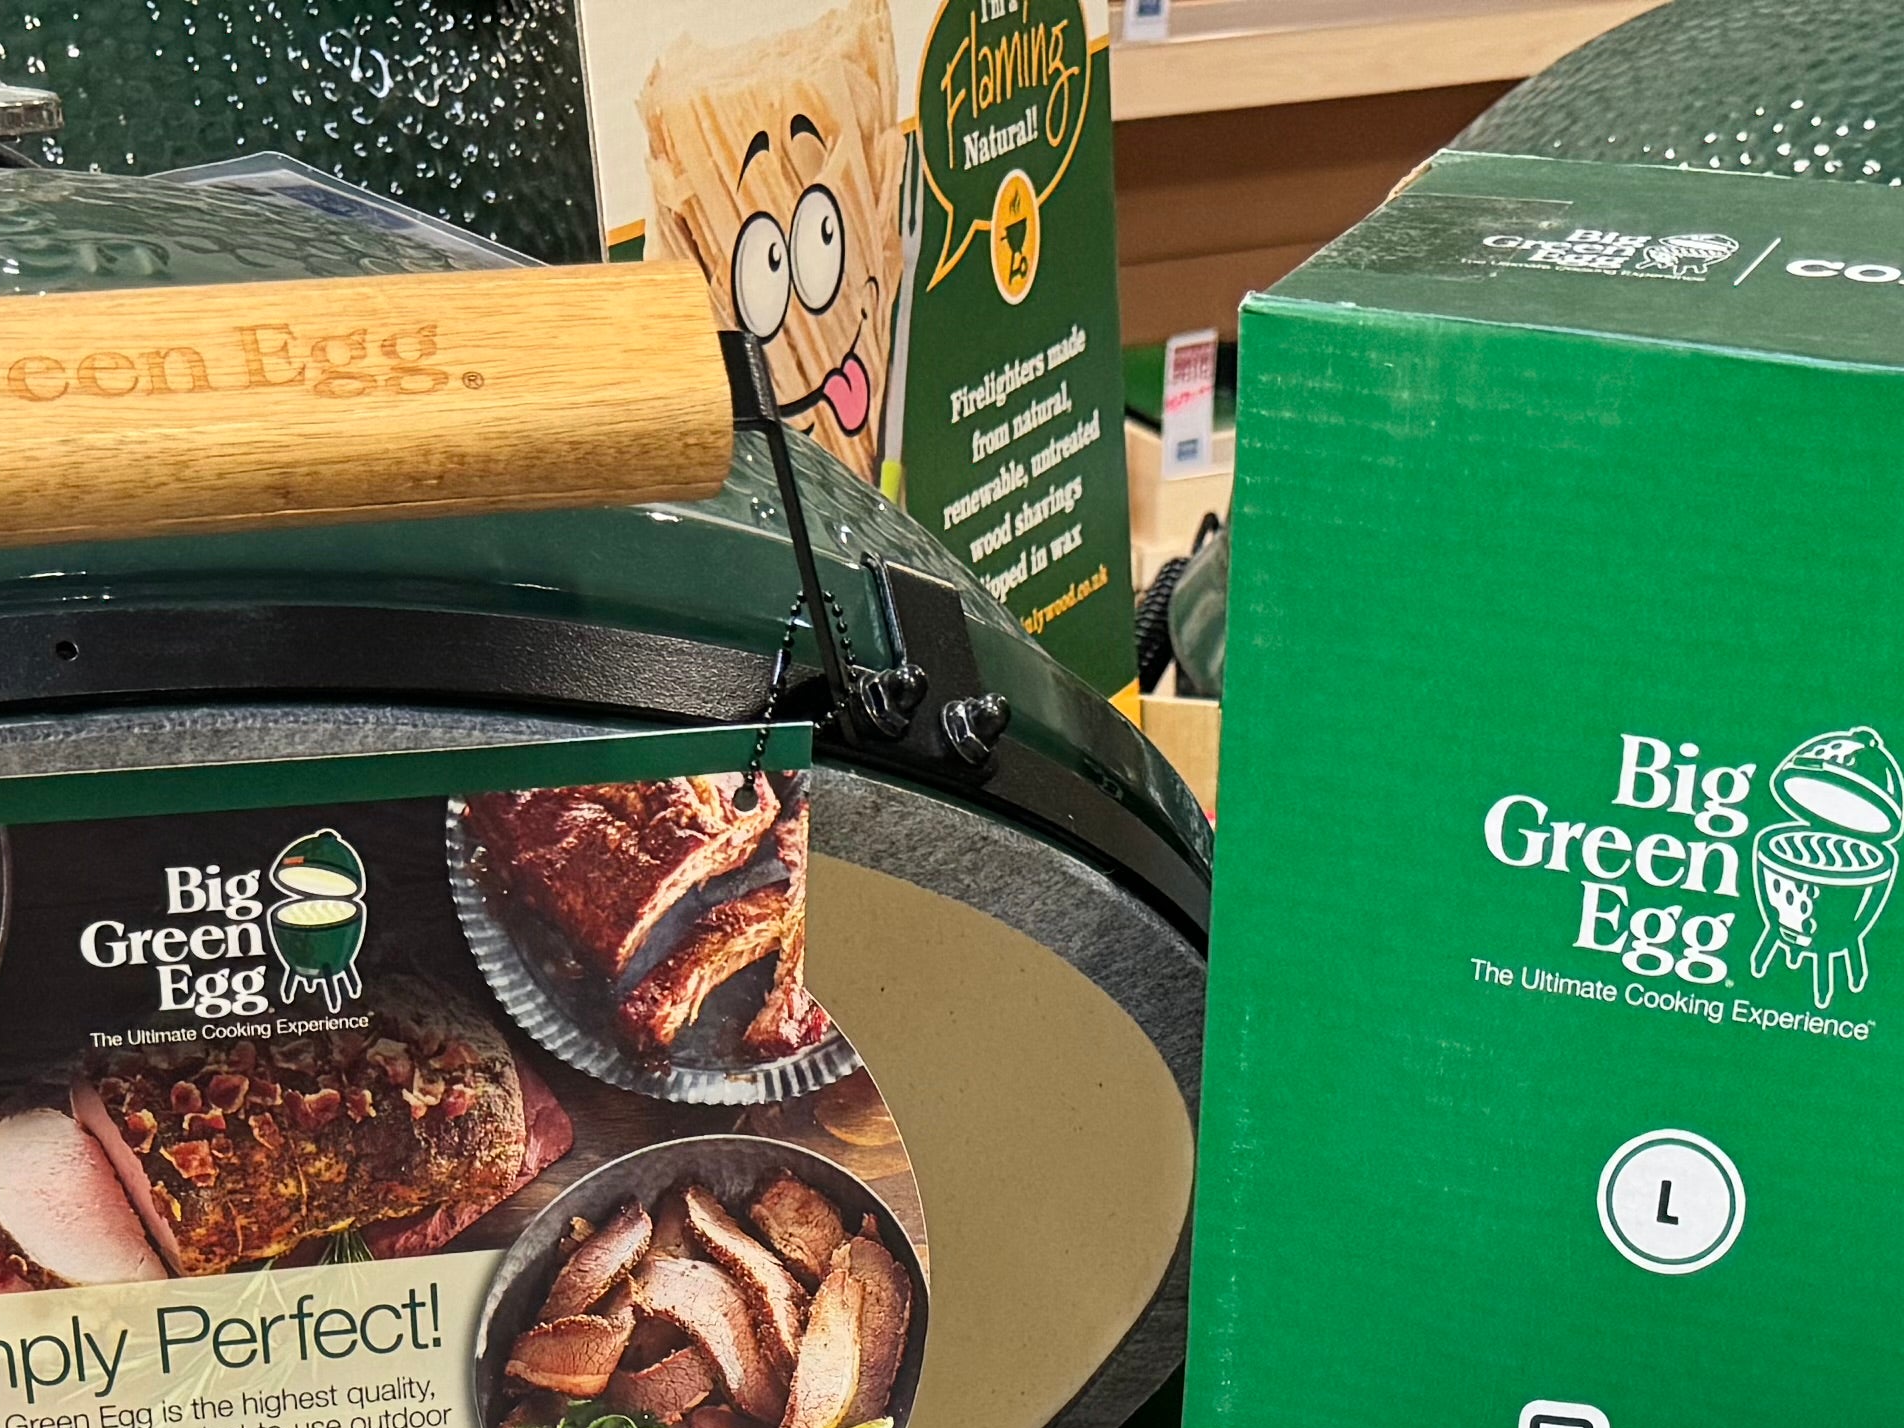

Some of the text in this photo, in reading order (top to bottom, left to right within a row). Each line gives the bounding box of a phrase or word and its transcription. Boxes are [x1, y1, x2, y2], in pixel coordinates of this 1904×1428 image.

[941, 10, 1080, 169] Flaming
[963, 104, 1038, 171] Natural!
[1482, 234, 1637, 257] Green
[1527, 249, 1630, 269] Egg
[1565, 229, 1652, 248] Big
[950, 324, 1086, 424] Firelighters made
[972, 380, 1072, 463] from natural,
[943, 409, 1101, 530] renewable, untreated
[970, 475, 1083, 562] wood shavings
[980, 523, 1083, 604] ipped in wax
[1611, 733, 1757, 838] Big
[1483, 794, 1740, 898] Green
[164, 864, 264, 921] Big
[80, 920, 267, 968] Green
[1572, 880, 1736, 984] Egg
[156, 963, 270, 1019] Egg
[1470, 957, 1514, 987] The
[1520, 966, 1618, 1003] Ultimate
[1622, 982, 1725, 1024] Cooking
[90, 1031, 123, 1048] The
[127, 1025, 197, 1046] Ultimate
[201, 1020, 273, 1041] Cooking
[1654, 1177, 1685, 1229] L
[156, 1282, 445, 1375] Perfect!
[161, 1399, 184, 1424] is
[192, 1396, 235, 1421] the
[242, 1384, 339, 1419] highest
[346, 1376, 437, 1406] quality,
